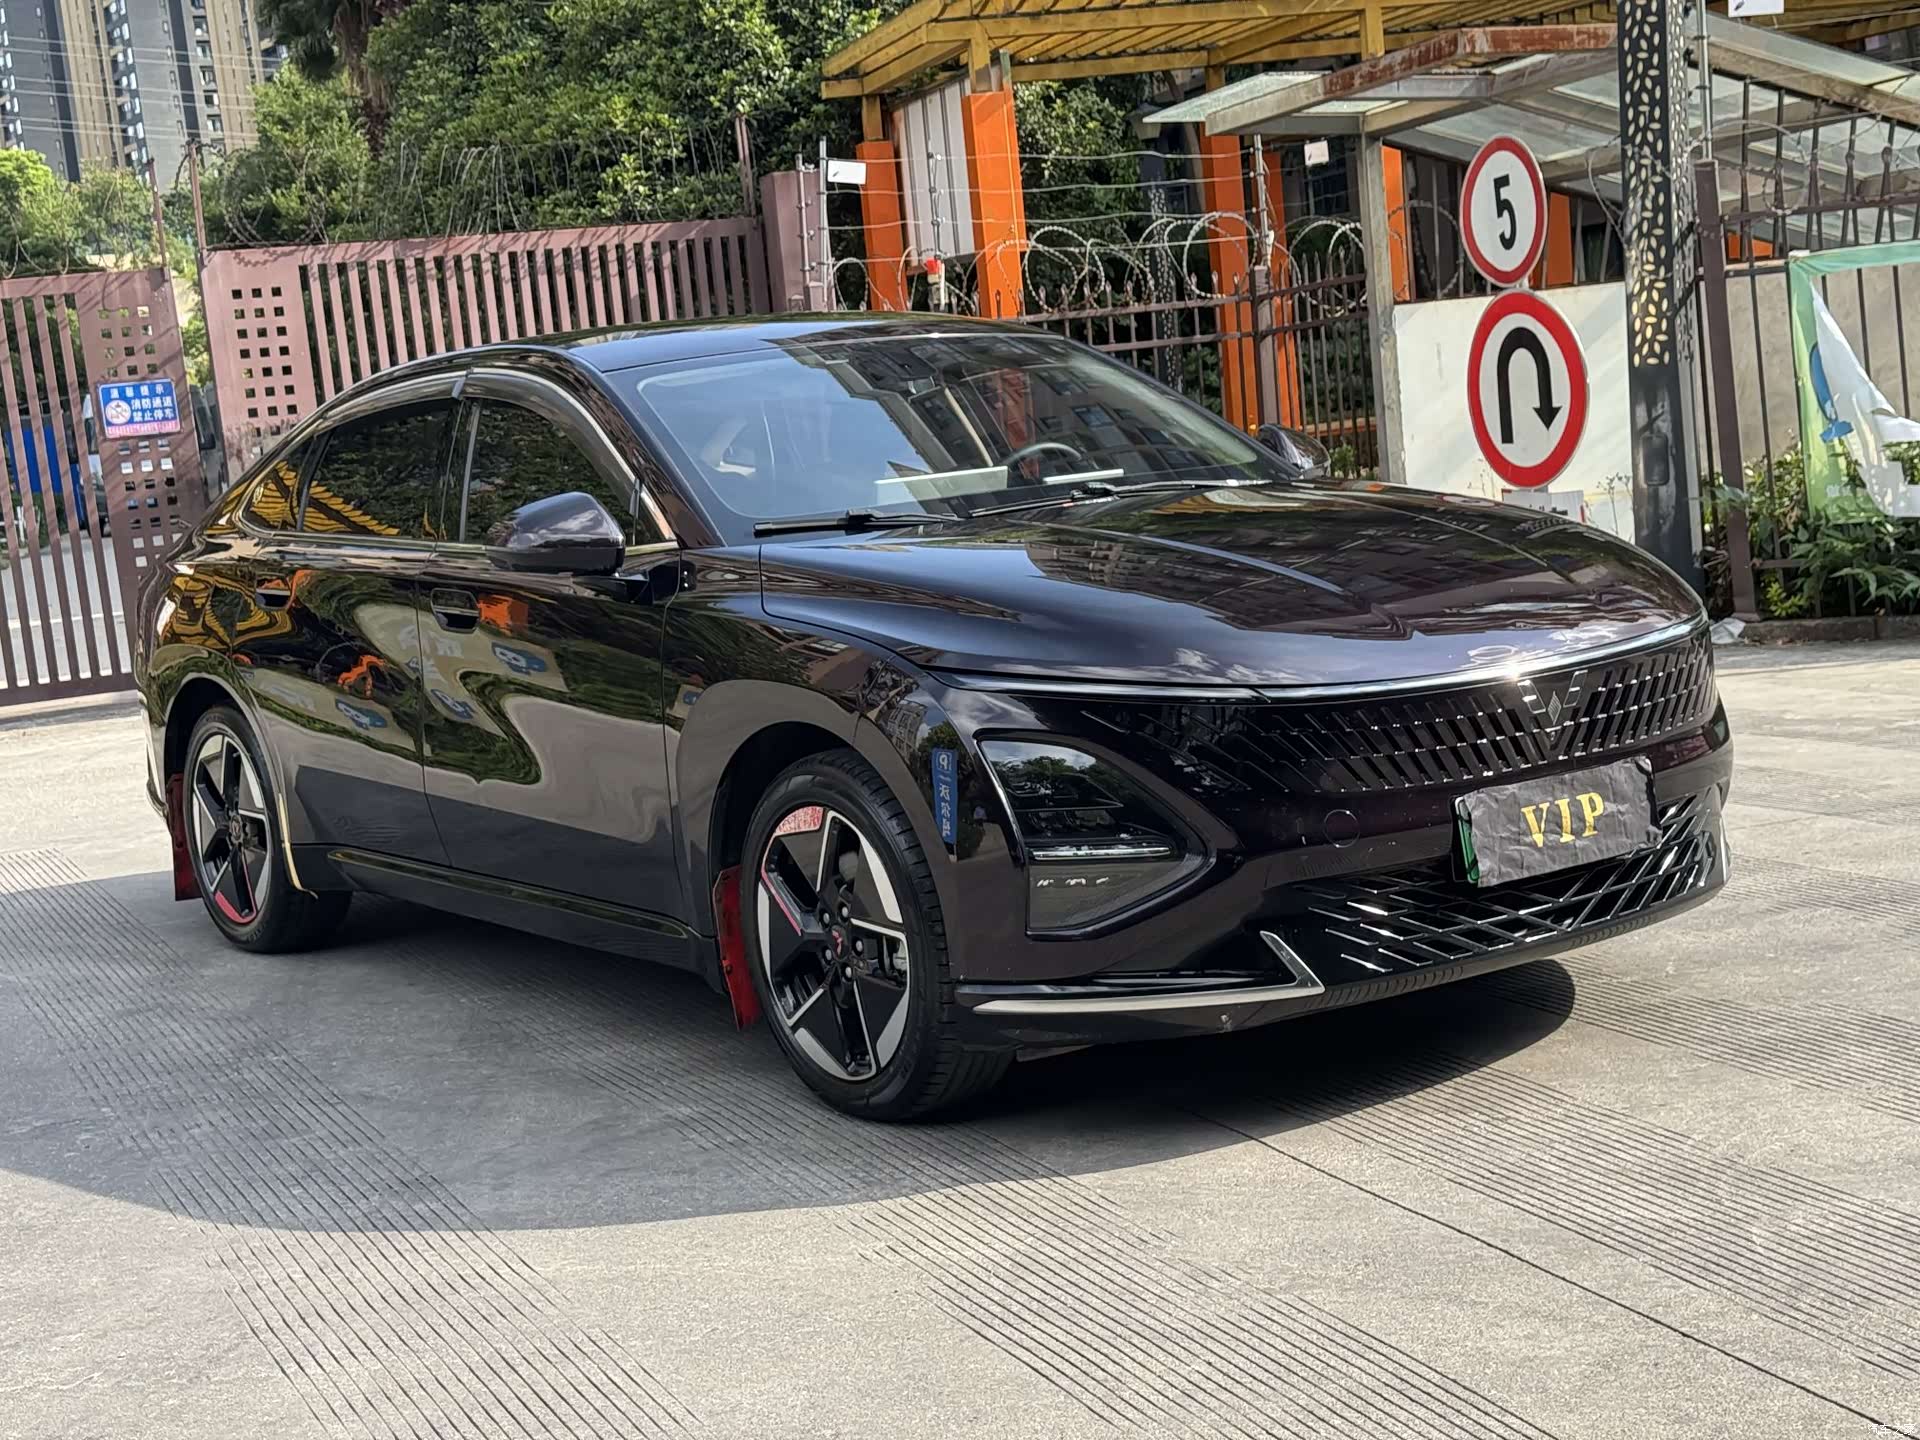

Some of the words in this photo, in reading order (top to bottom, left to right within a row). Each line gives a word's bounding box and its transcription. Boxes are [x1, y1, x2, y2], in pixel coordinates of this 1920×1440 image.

[1493, 173, 1517, 251] 5
[130, 396, 173, 410] 消防通道
[132, 408, 175, 423] 禁止停车
[1520, 792, 1605, 848] VIP
